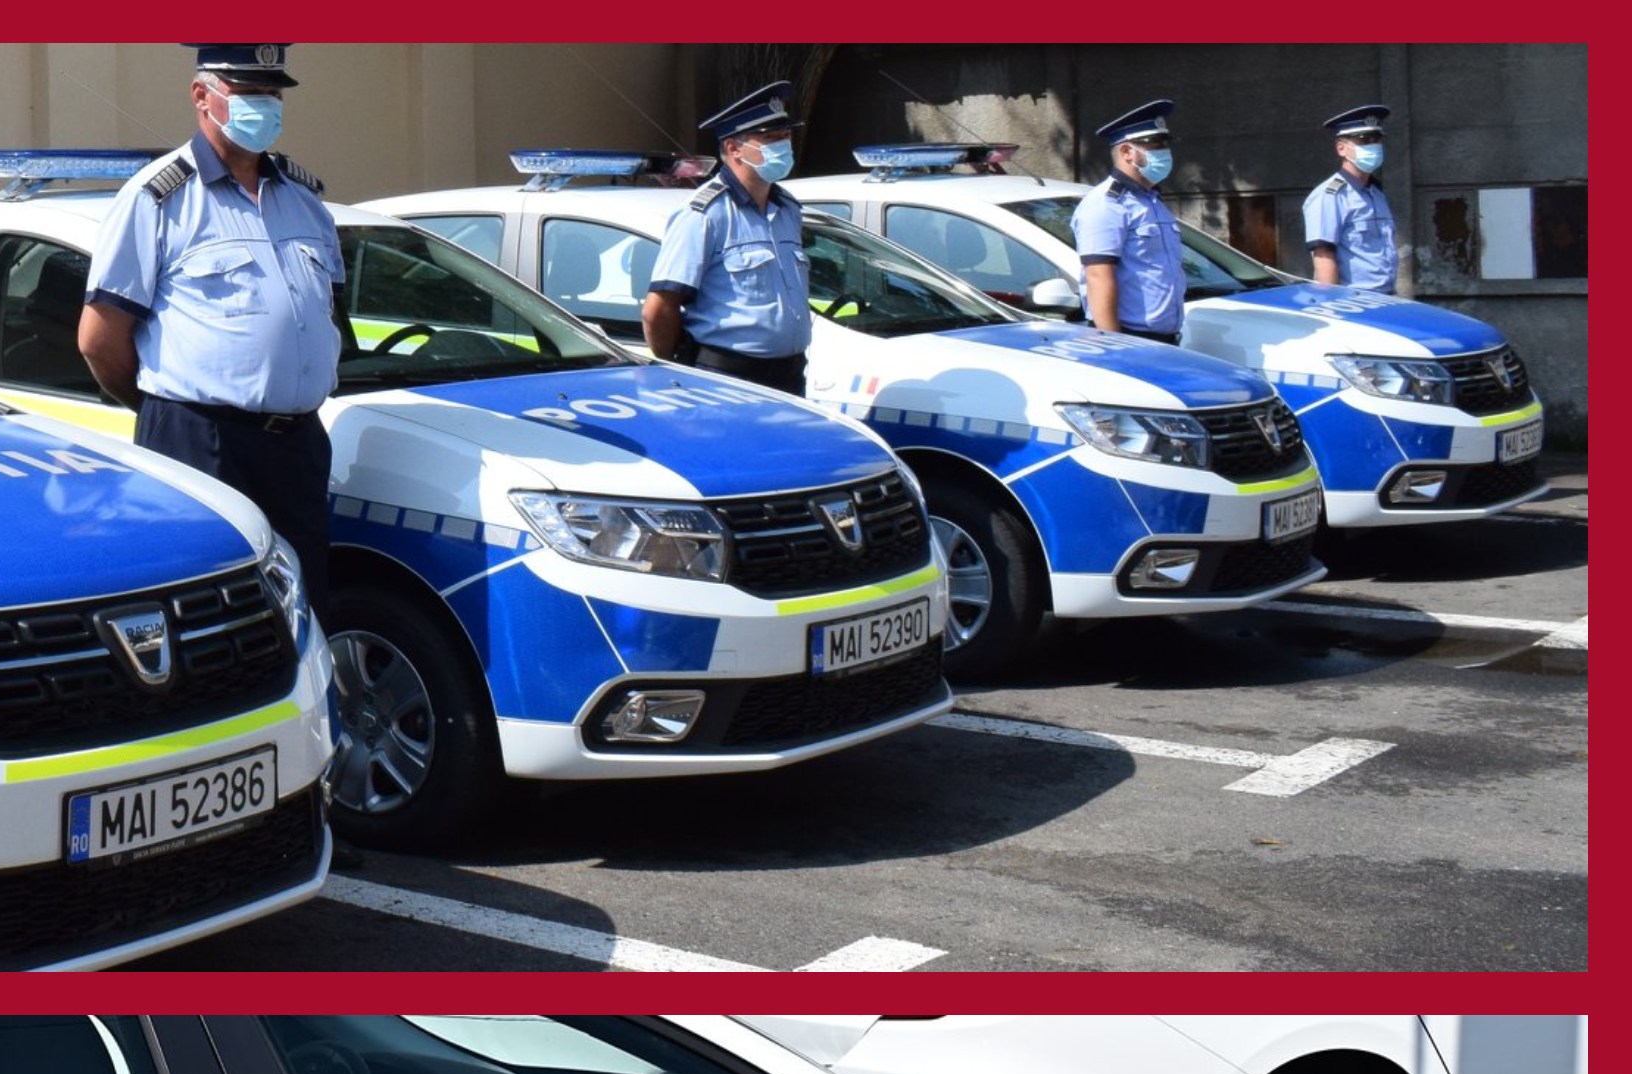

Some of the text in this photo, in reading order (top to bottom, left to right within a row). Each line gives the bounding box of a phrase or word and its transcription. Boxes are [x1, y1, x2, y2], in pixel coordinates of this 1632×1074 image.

[830, 624, 863, 666] MAI
[870, 608, 923, 655] 52390
[101, 761, 265, 849] MAI 52386
[71, 833, 89, 855] RO
